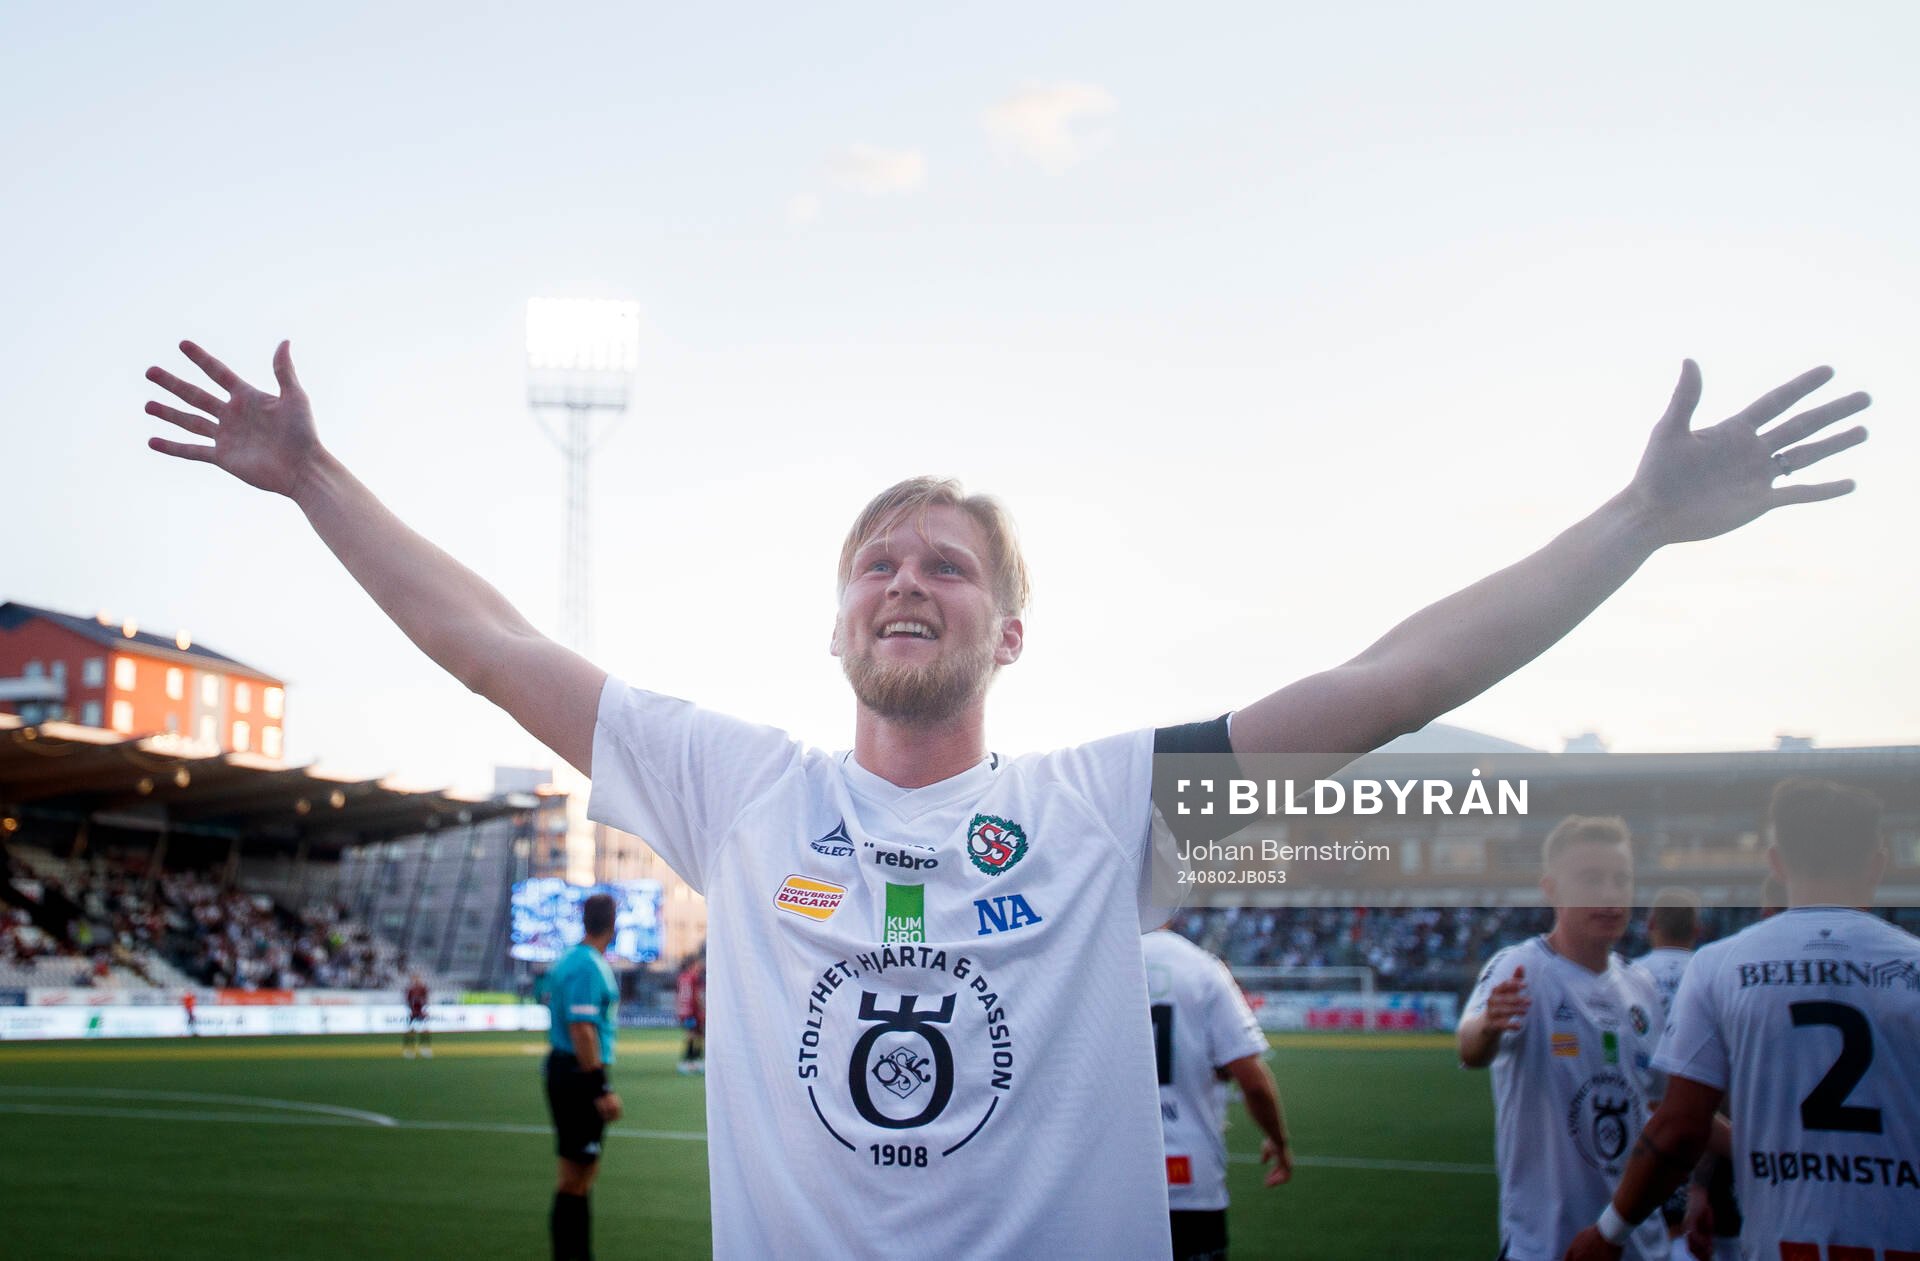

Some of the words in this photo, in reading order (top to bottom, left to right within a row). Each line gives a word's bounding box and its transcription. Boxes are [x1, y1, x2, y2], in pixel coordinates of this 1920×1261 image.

[810, 841, 855, 857] SELECT
[864, 842, 938, 870] rebro
[778, 893, 840, 907] BAGARN
[887, 916, 921, 931] KUM
[973, 894, 1042, 935] NA
[887, 930, 922, 943] BRO
[1738, 959, 1872, 988] BEHRN
[798, 960, 860, 1079] STOLTHET,
[856, 944, 947, 974] HJÄRTA
[953, 957, 971, 979] &
[970, 975, 1013, 1090] PASSION
[1789, 999, 1883, 1134] 2
[870, 1144, 928, 1168] 1908
[1751, 1152, 1920, 1189] BJØRNSTA
